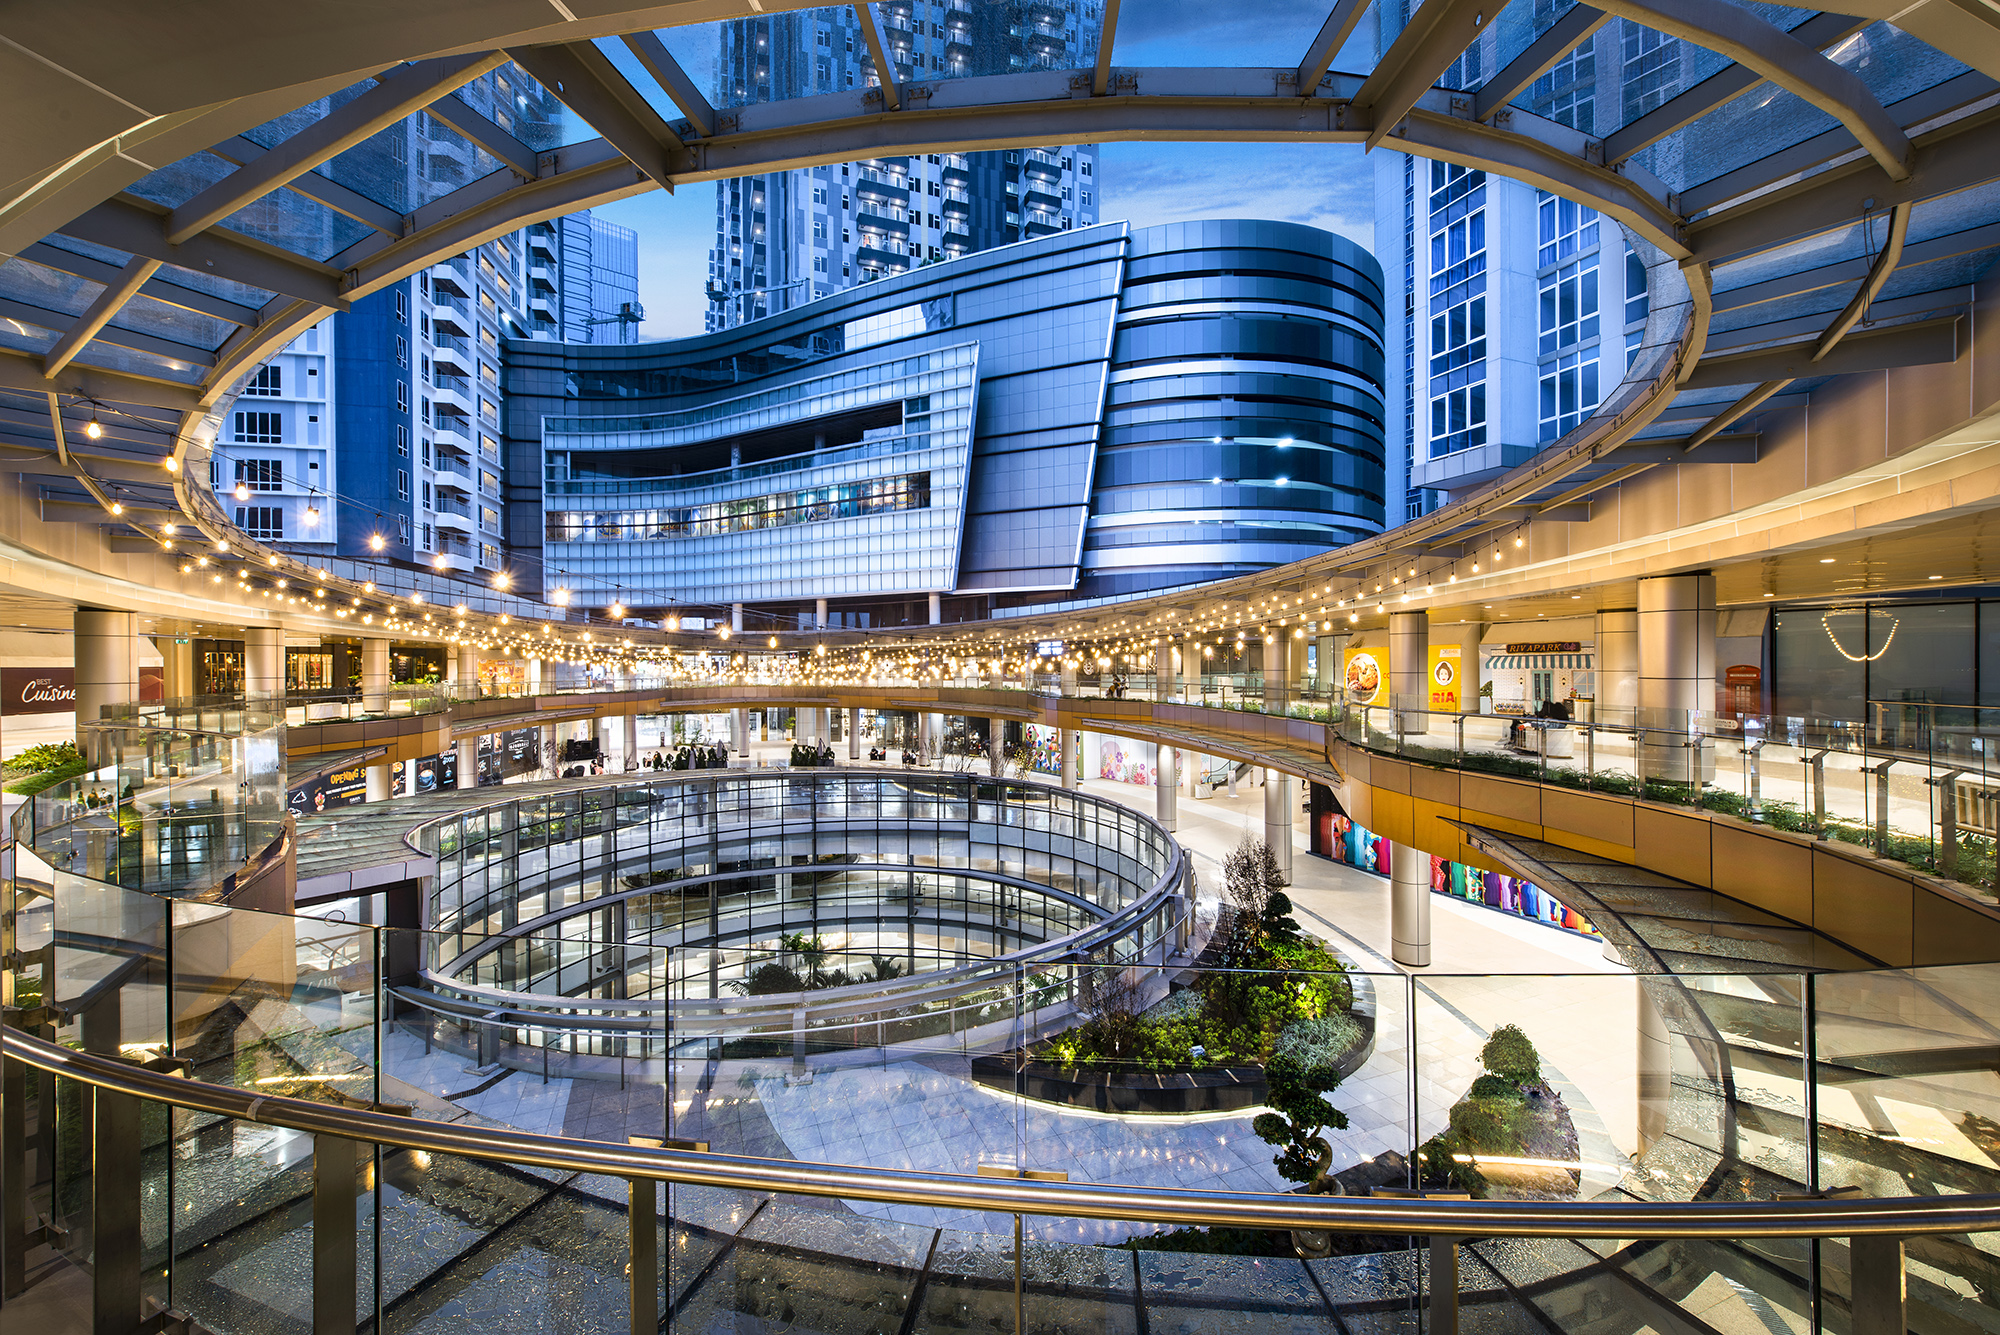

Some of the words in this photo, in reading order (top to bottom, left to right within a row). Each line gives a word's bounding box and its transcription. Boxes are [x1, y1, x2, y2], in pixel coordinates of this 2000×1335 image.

[21, 680, 76, 703] Cuisine
[1432, 692, 1455, 703] RIA
[330, 768, 358, 784] OPENING
[360, 768, 366, 779] S
